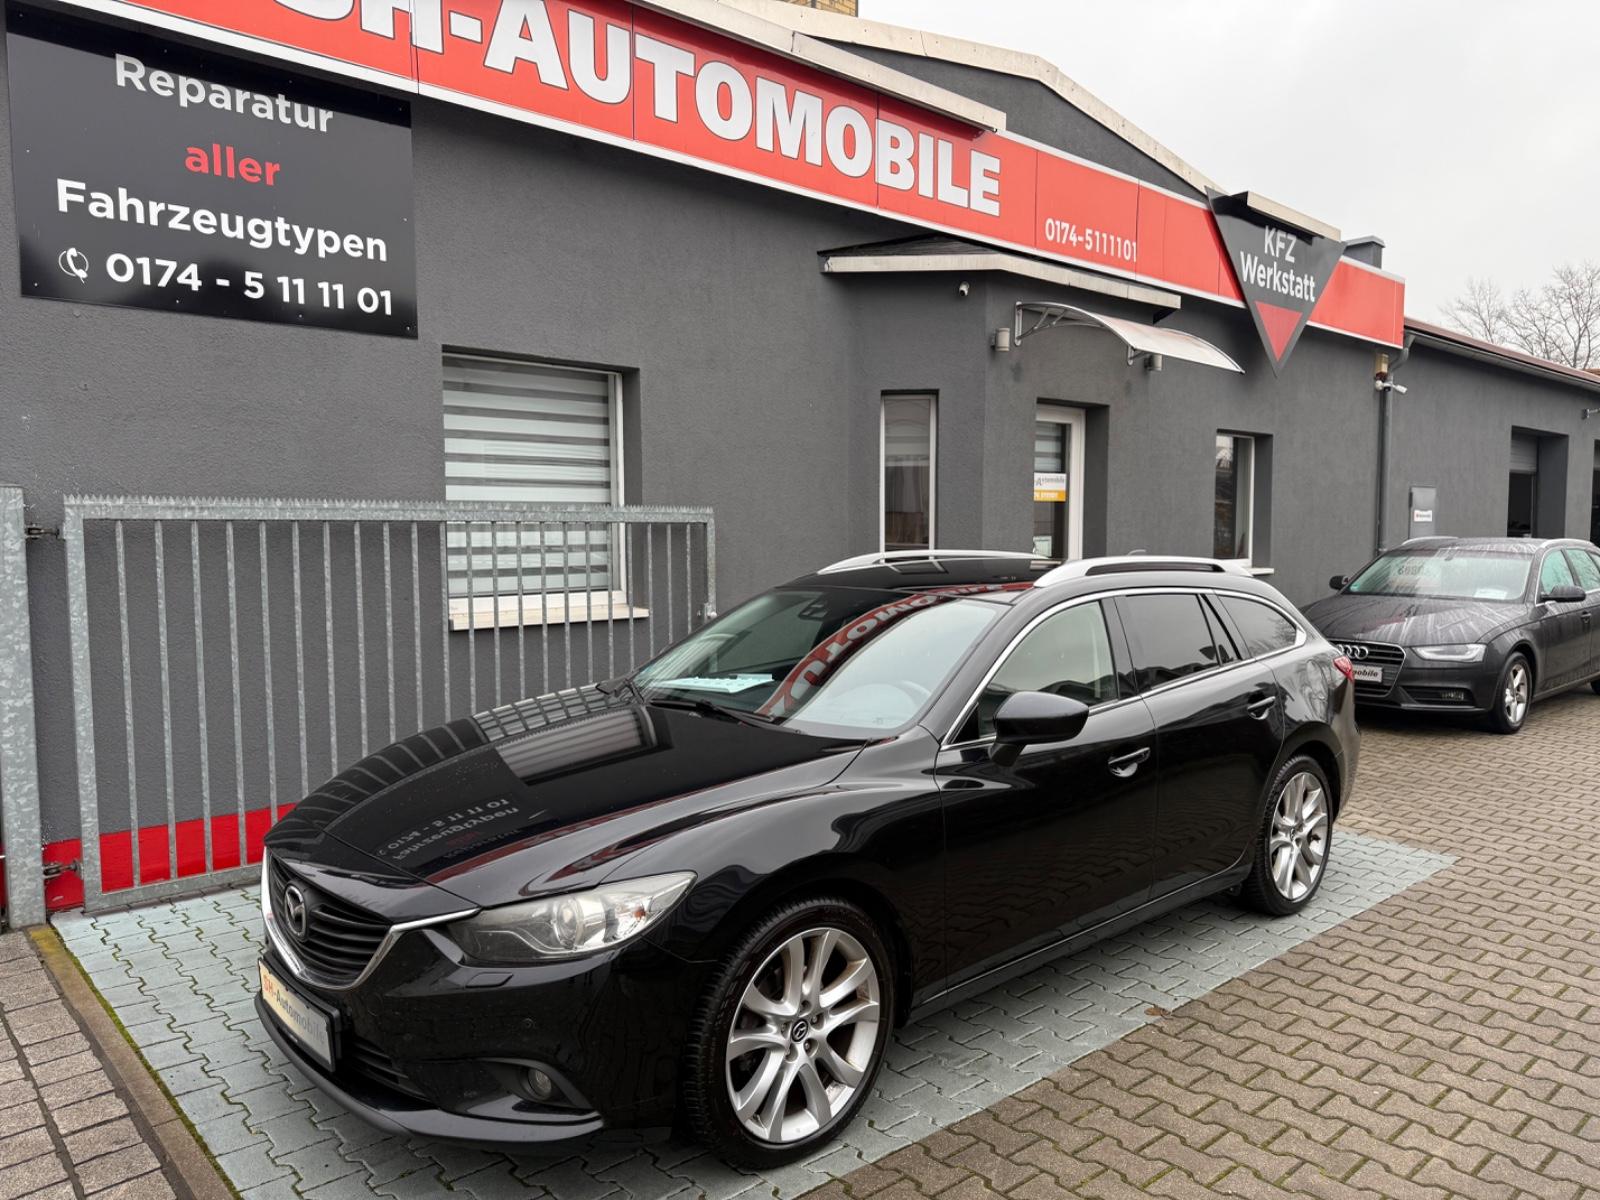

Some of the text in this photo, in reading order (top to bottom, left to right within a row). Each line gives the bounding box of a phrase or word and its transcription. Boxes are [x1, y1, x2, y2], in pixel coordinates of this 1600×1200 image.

[115, 53, 334, 132] Reparatur
[185, 143, 280, 186] aller
[56, 178, 388, 262] Fahrzeugtypen
[1045, 217, 1137, 263] 0174-5111101
[1264, 226, 1296, 263] KFZ
[106, 253, 202, 291] 0174
[243, 270, 265, 299] 5
[277, 276, 305, 305] 11
[317, 281, 345, 310] 11
[357, 287, 392, 316] 01
[1240, 251, 1316, 302] Werkstatt
